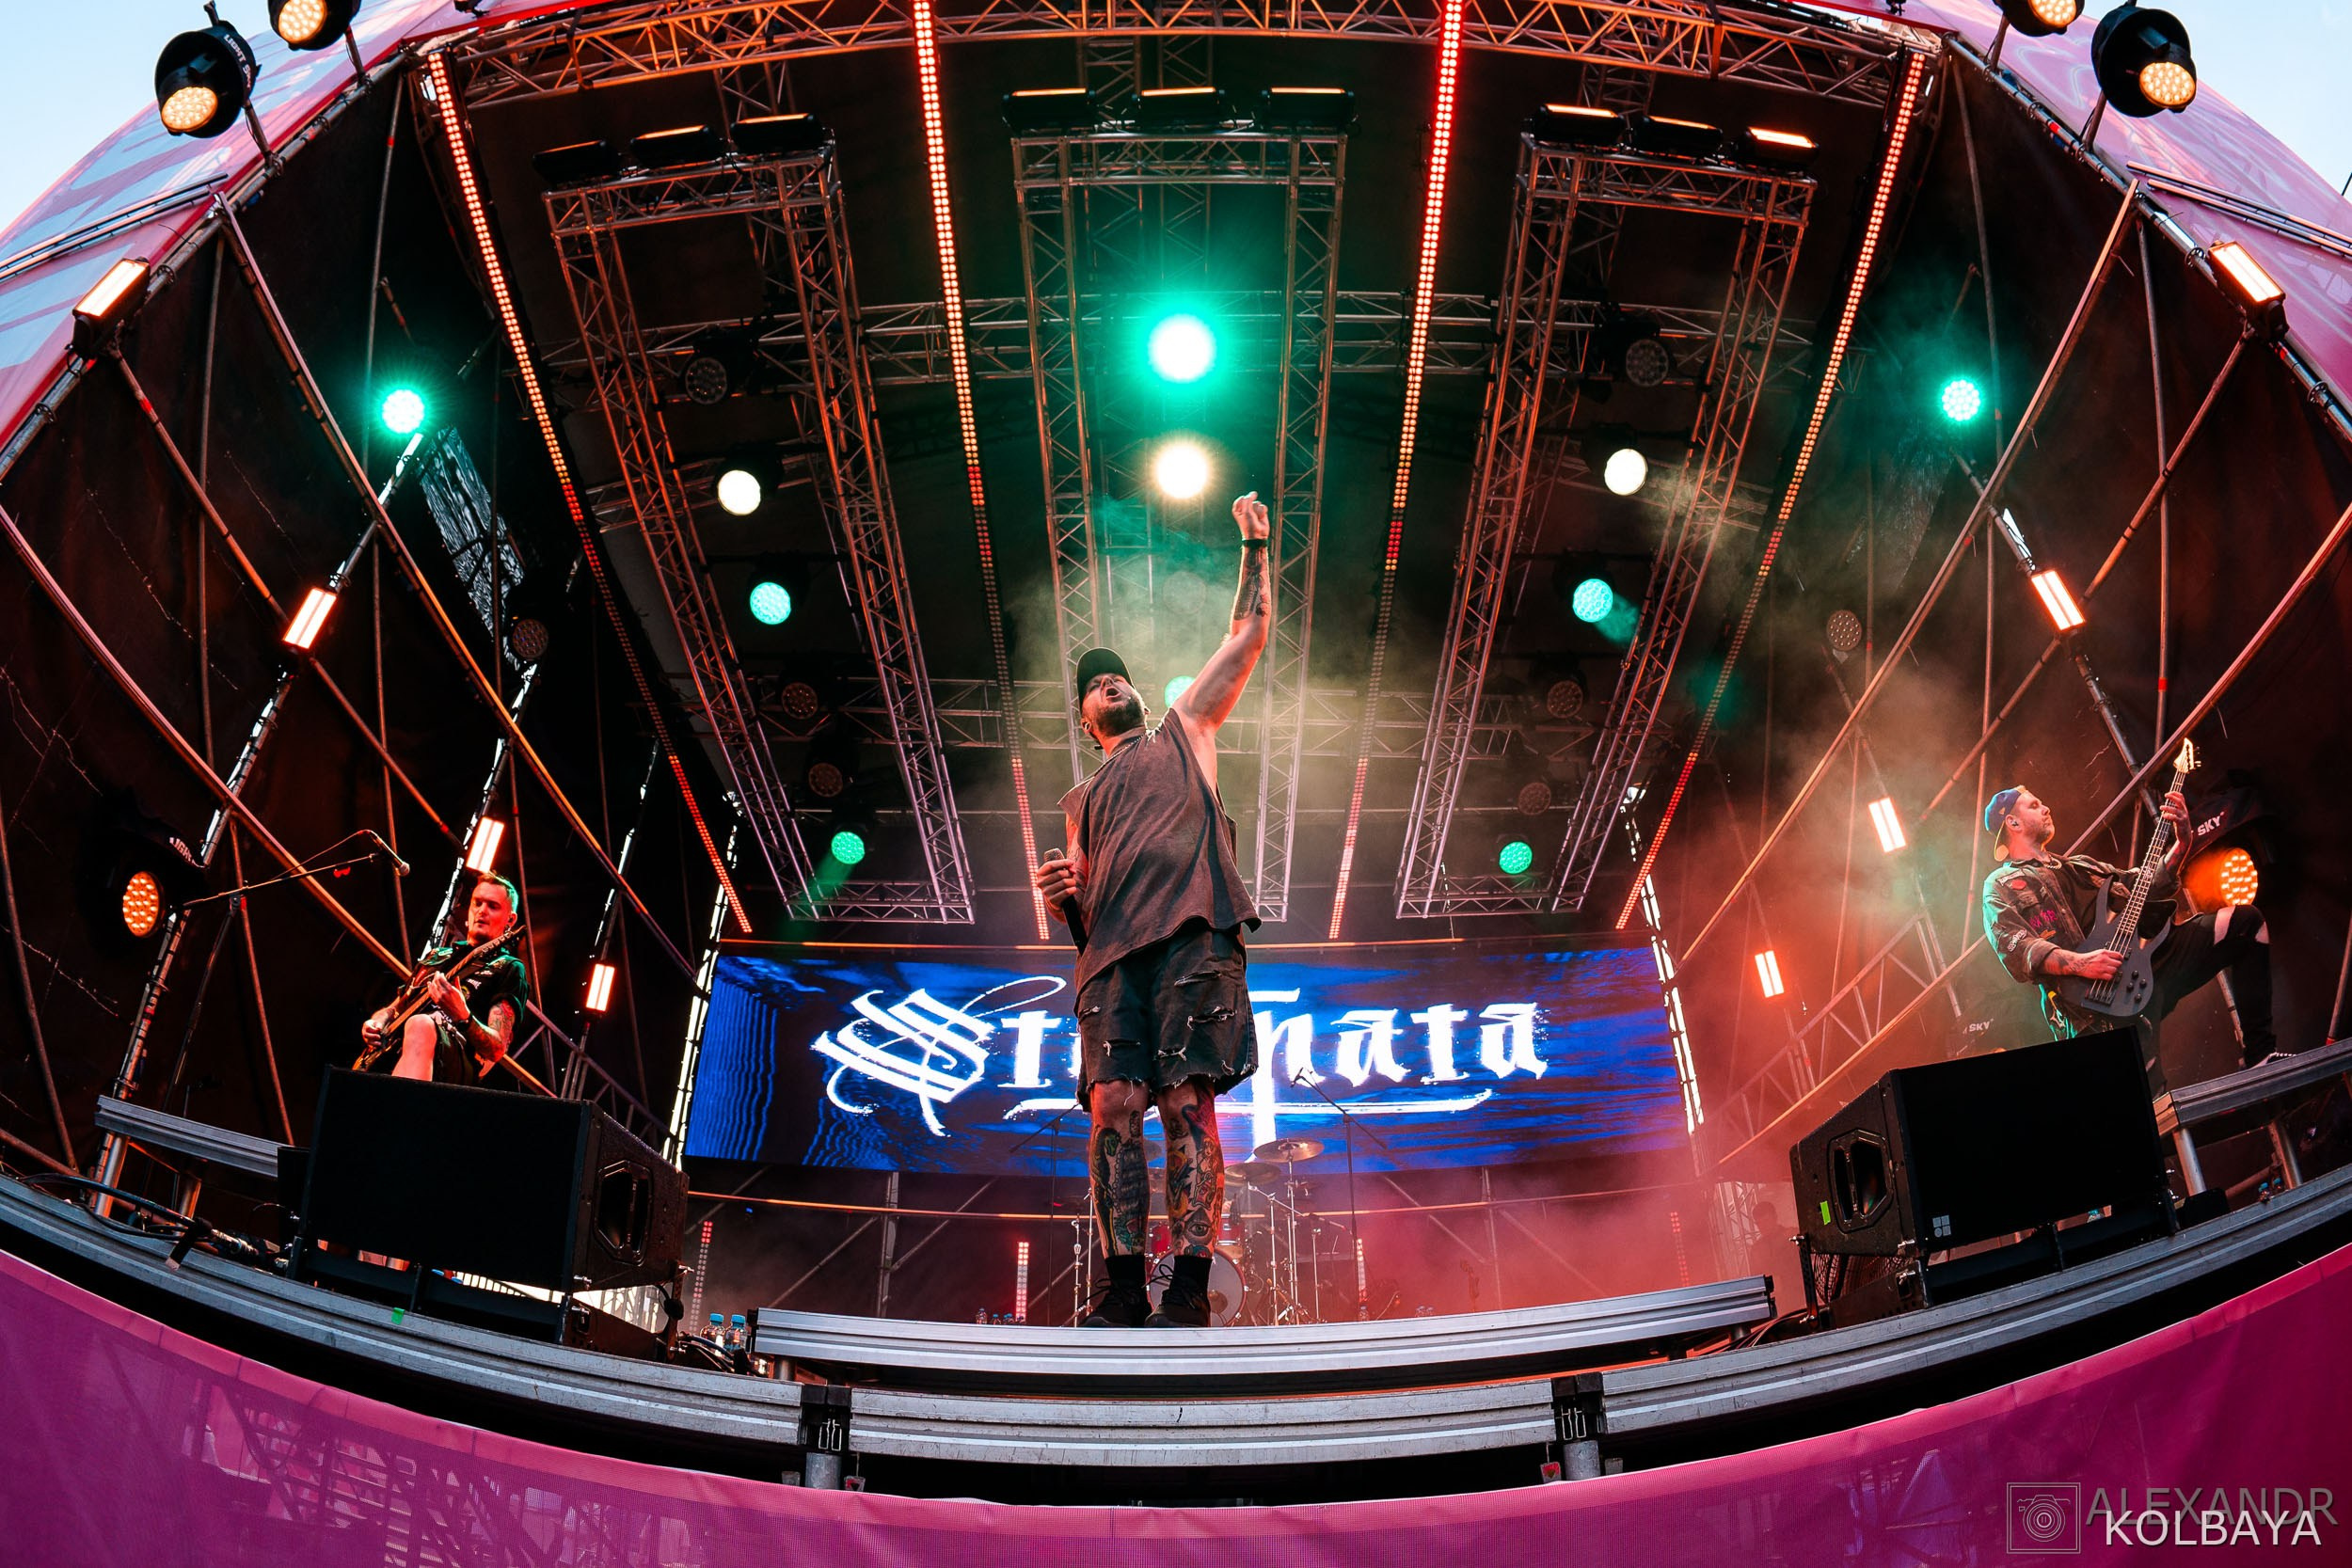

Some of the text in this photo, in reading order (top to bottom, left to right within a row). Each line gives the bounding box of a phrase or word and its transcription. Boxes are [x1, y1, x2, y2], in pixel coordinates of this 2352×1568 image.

[224, 34, 246, 62] LIGHT
[2198, 816, 2220, 835] SKY
[1969, 1022, 1990, 1032] SKY
